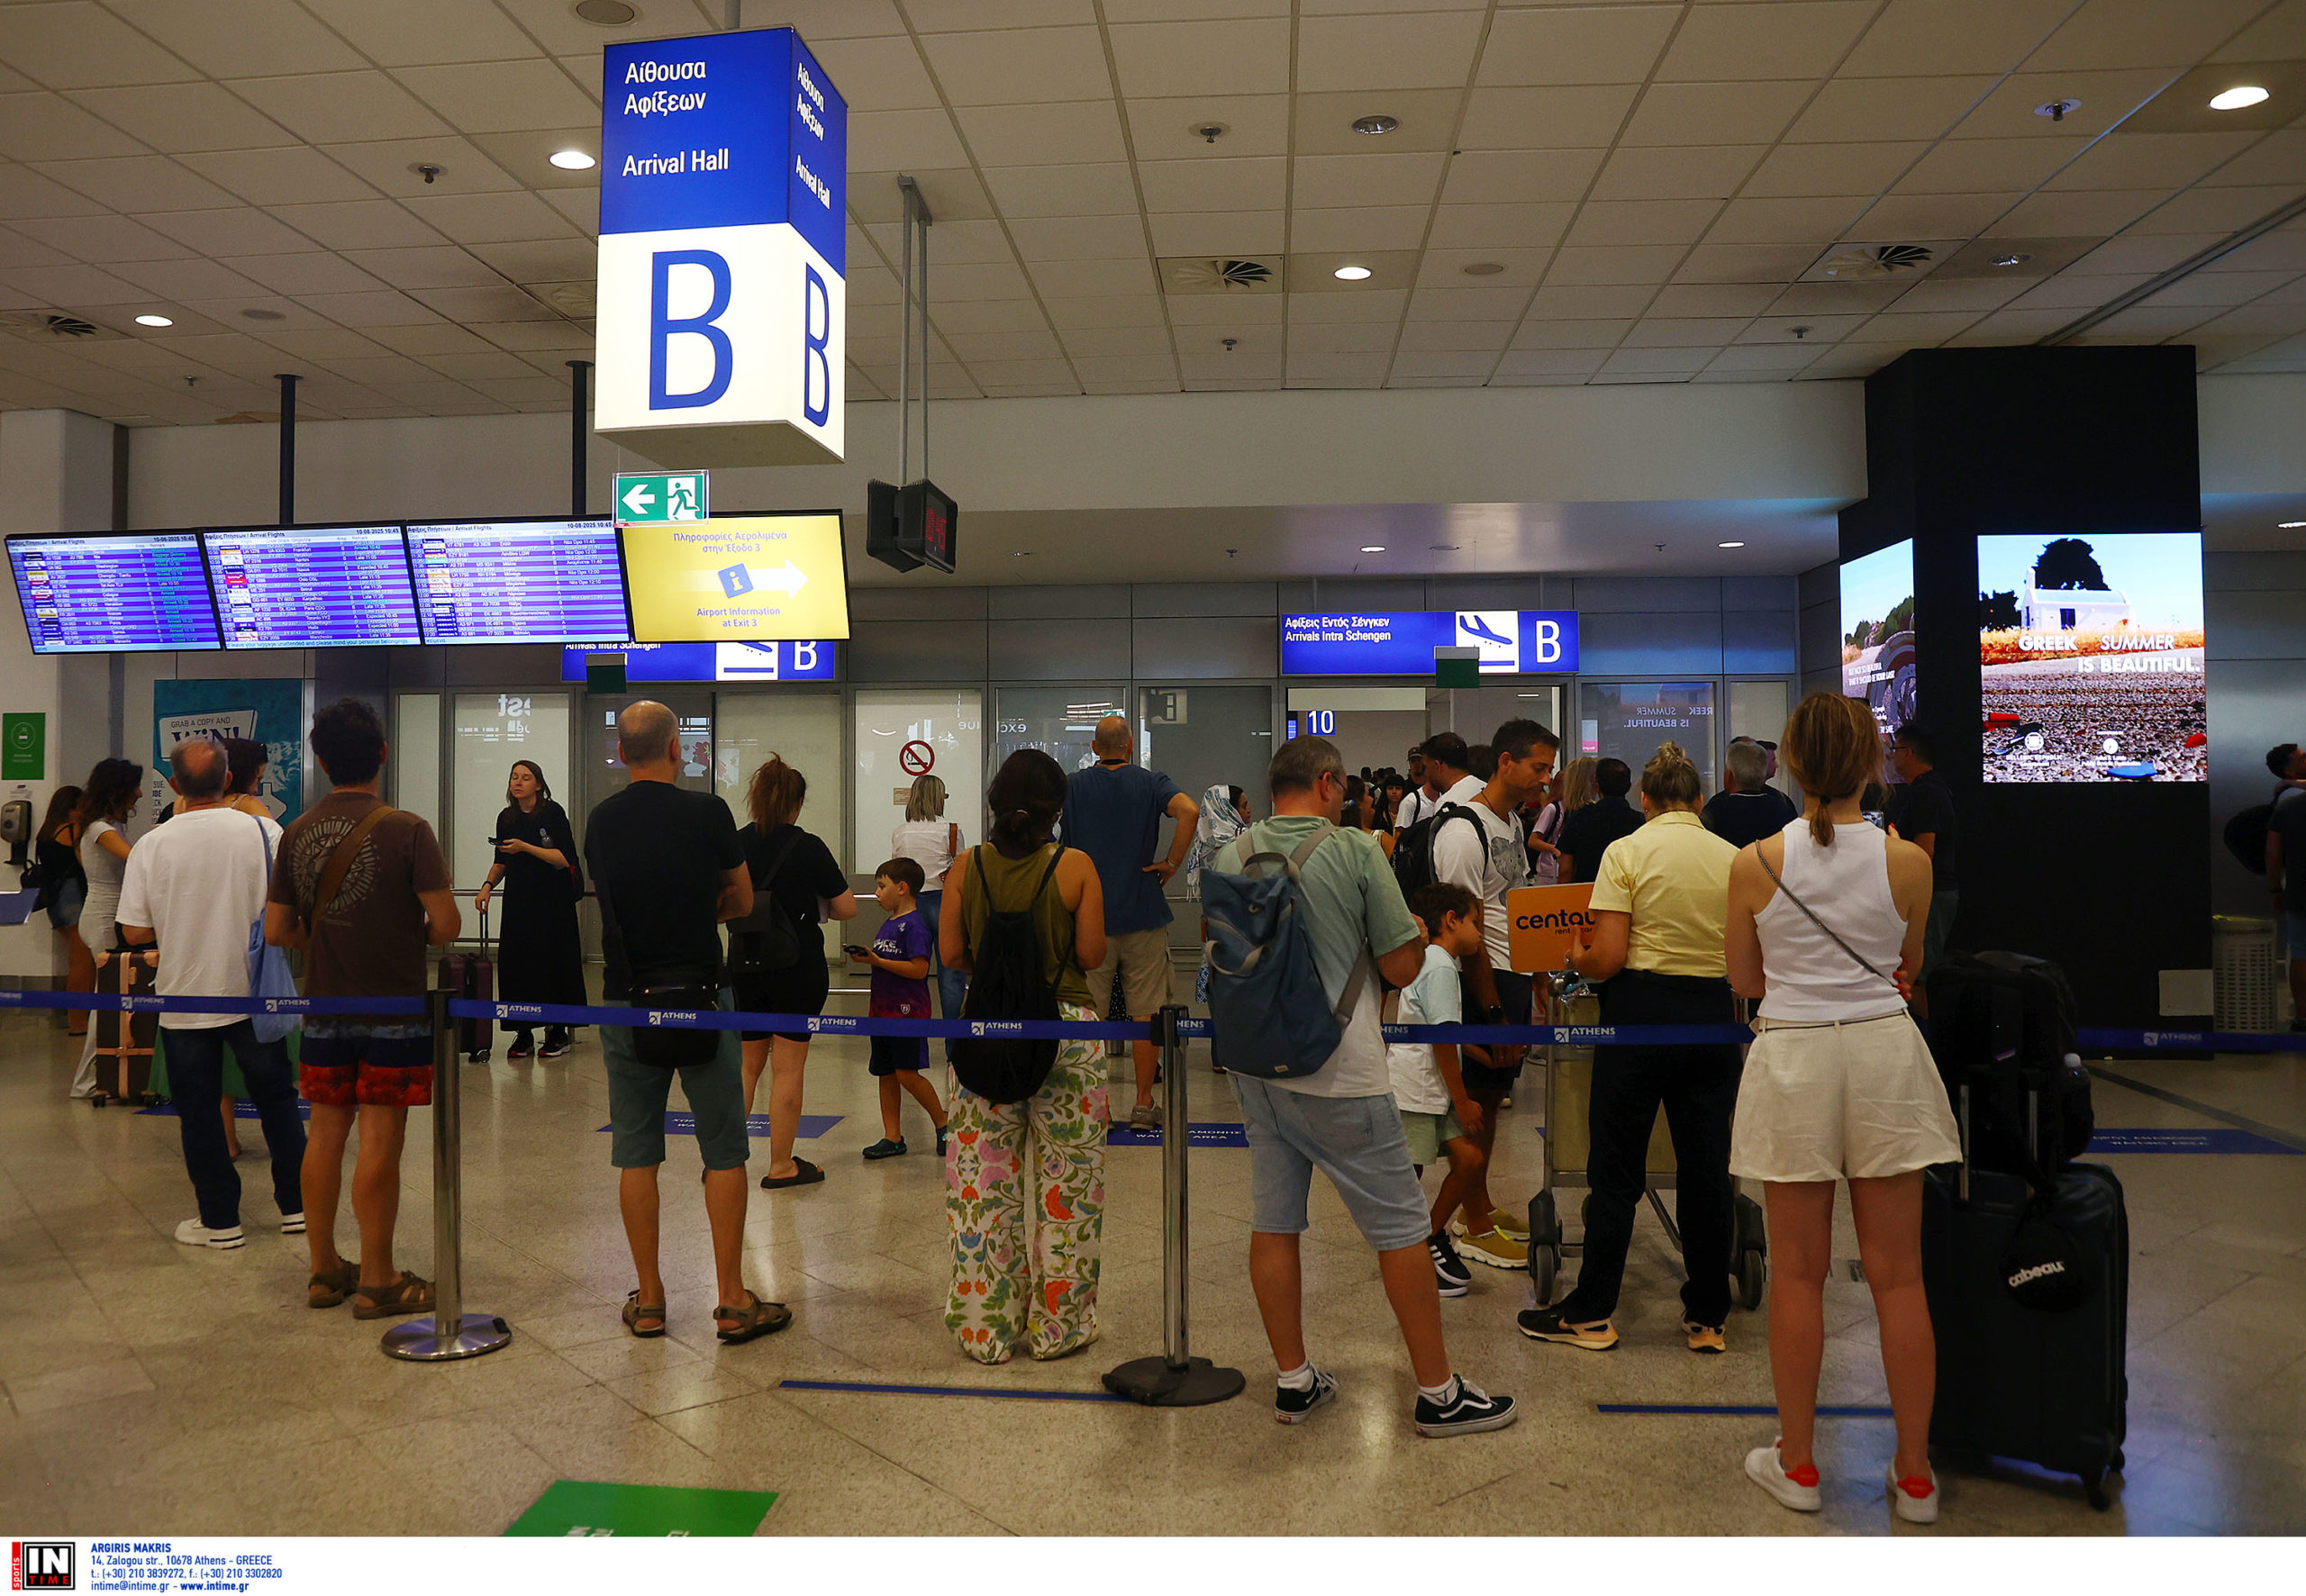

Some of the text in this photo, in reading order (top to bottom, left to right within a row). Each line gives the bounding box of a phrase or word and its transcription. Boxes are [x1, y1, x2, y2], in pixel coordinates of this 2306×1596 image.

[624, 60, 707, 85] Αίθουσα
[796, 62, 825, 113] Αίθουσα
[623, 90, 707, 116] Αφίξεων
[622, 149, 730, 177] Arrival Hall
[794, 155, 831, 210] Arrival Hall
[649, 249, 733, 411] B
[803, 261, 830, 428] B
[673, 530, 788, 543] Πληροφορίες Αερολιμένα
[702, 544, 724, 553] στην
[755, 543, 761, 552] 3
[696, 606, 781, 618] Airport Information
[722, 618, 758, 628] at Exit 3
[1285, 616, 1390, 630] Αφίξεις Εντός Σένγκεν
[1285, 630, 1392, 643] Arrivals Intra Schengen
[1535, 620, 1562, 664] B
[2018, 633, 2175, 651] GREEK SUMMER
[2077, 657, 2201, 673] IS BEAUTIFUL.
[171, 720, 189, 729] GRAB
[1308, 710, 1334, 734] 10
[1555, 928, 1571, 936] rent
[509, 1005, 541, 1013] ATHENS
[662, 1011, 697, 1020] ATHENS
[822, 1018, 857, 1026] ATHENS
[985, 1021, 1022, 1029] ATHENS
[1571, 1027, 1616, 1036] ATHENS
[2008, 1261, 2065, 1288] cabeau
